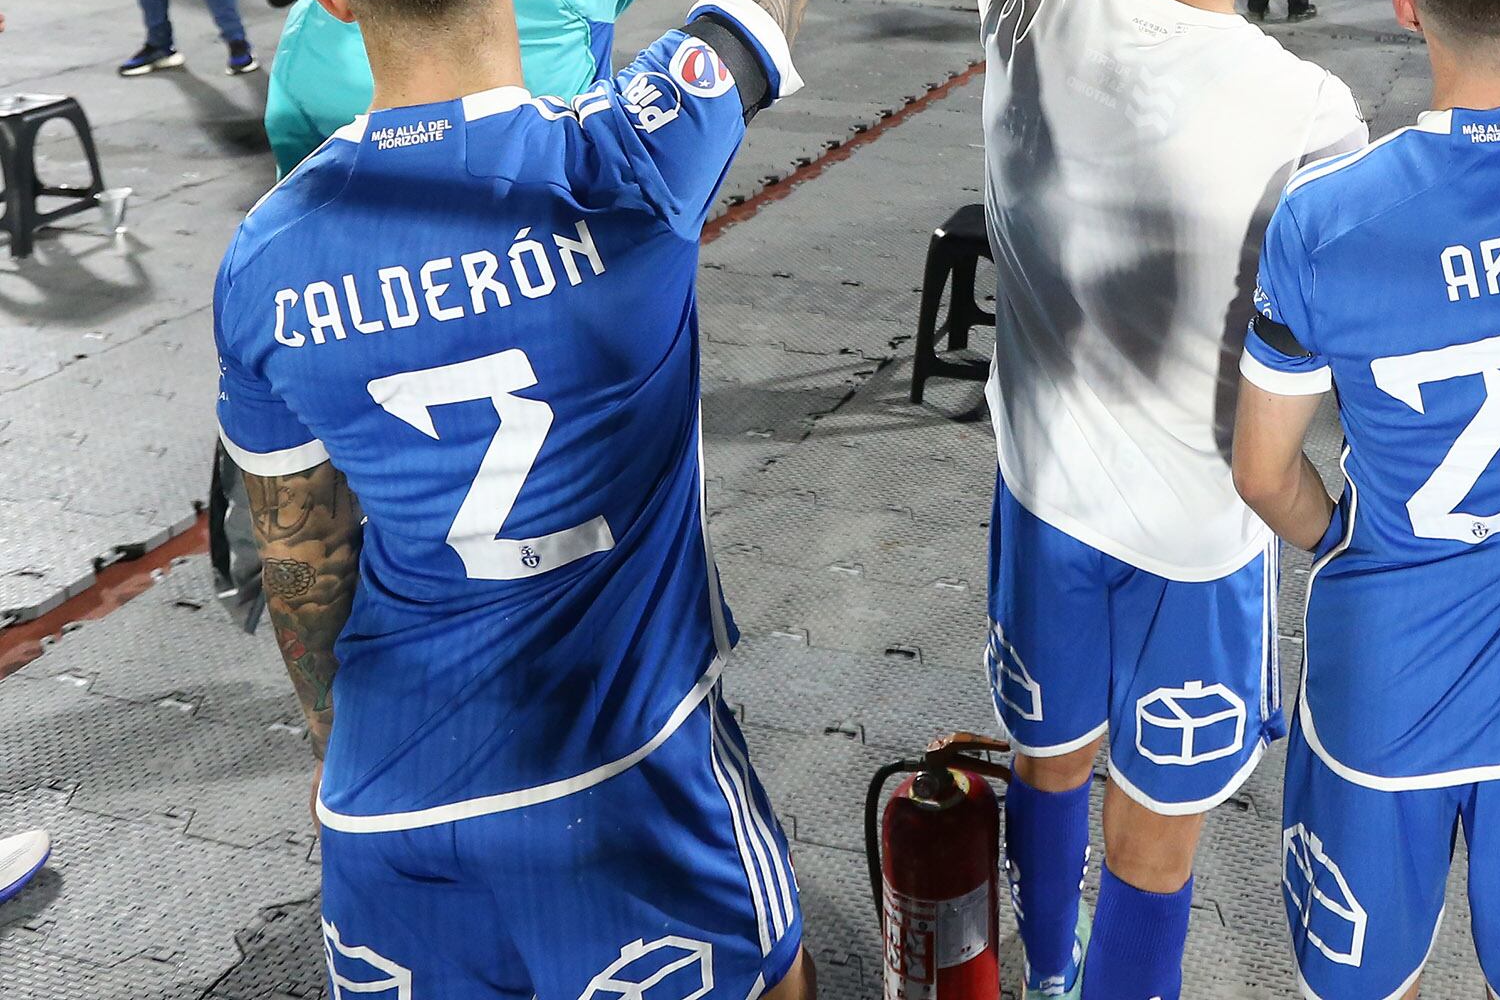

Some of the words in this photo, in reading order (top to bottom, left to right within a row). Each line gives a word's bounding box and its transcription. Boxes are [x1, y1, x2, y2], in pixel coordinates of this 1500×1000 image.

[370, 128, 394, 142] MÁS
[395, 120, 426, 138] ALLÁ
[427, 119, 453, 132] DEL
[378, 130, 444, 150] HORIZONTE
[1462, 122, 1486, 136] MÁS
[273, 219, 607, 348] CALDERÓN
[366, 347, 616, 581] 2
